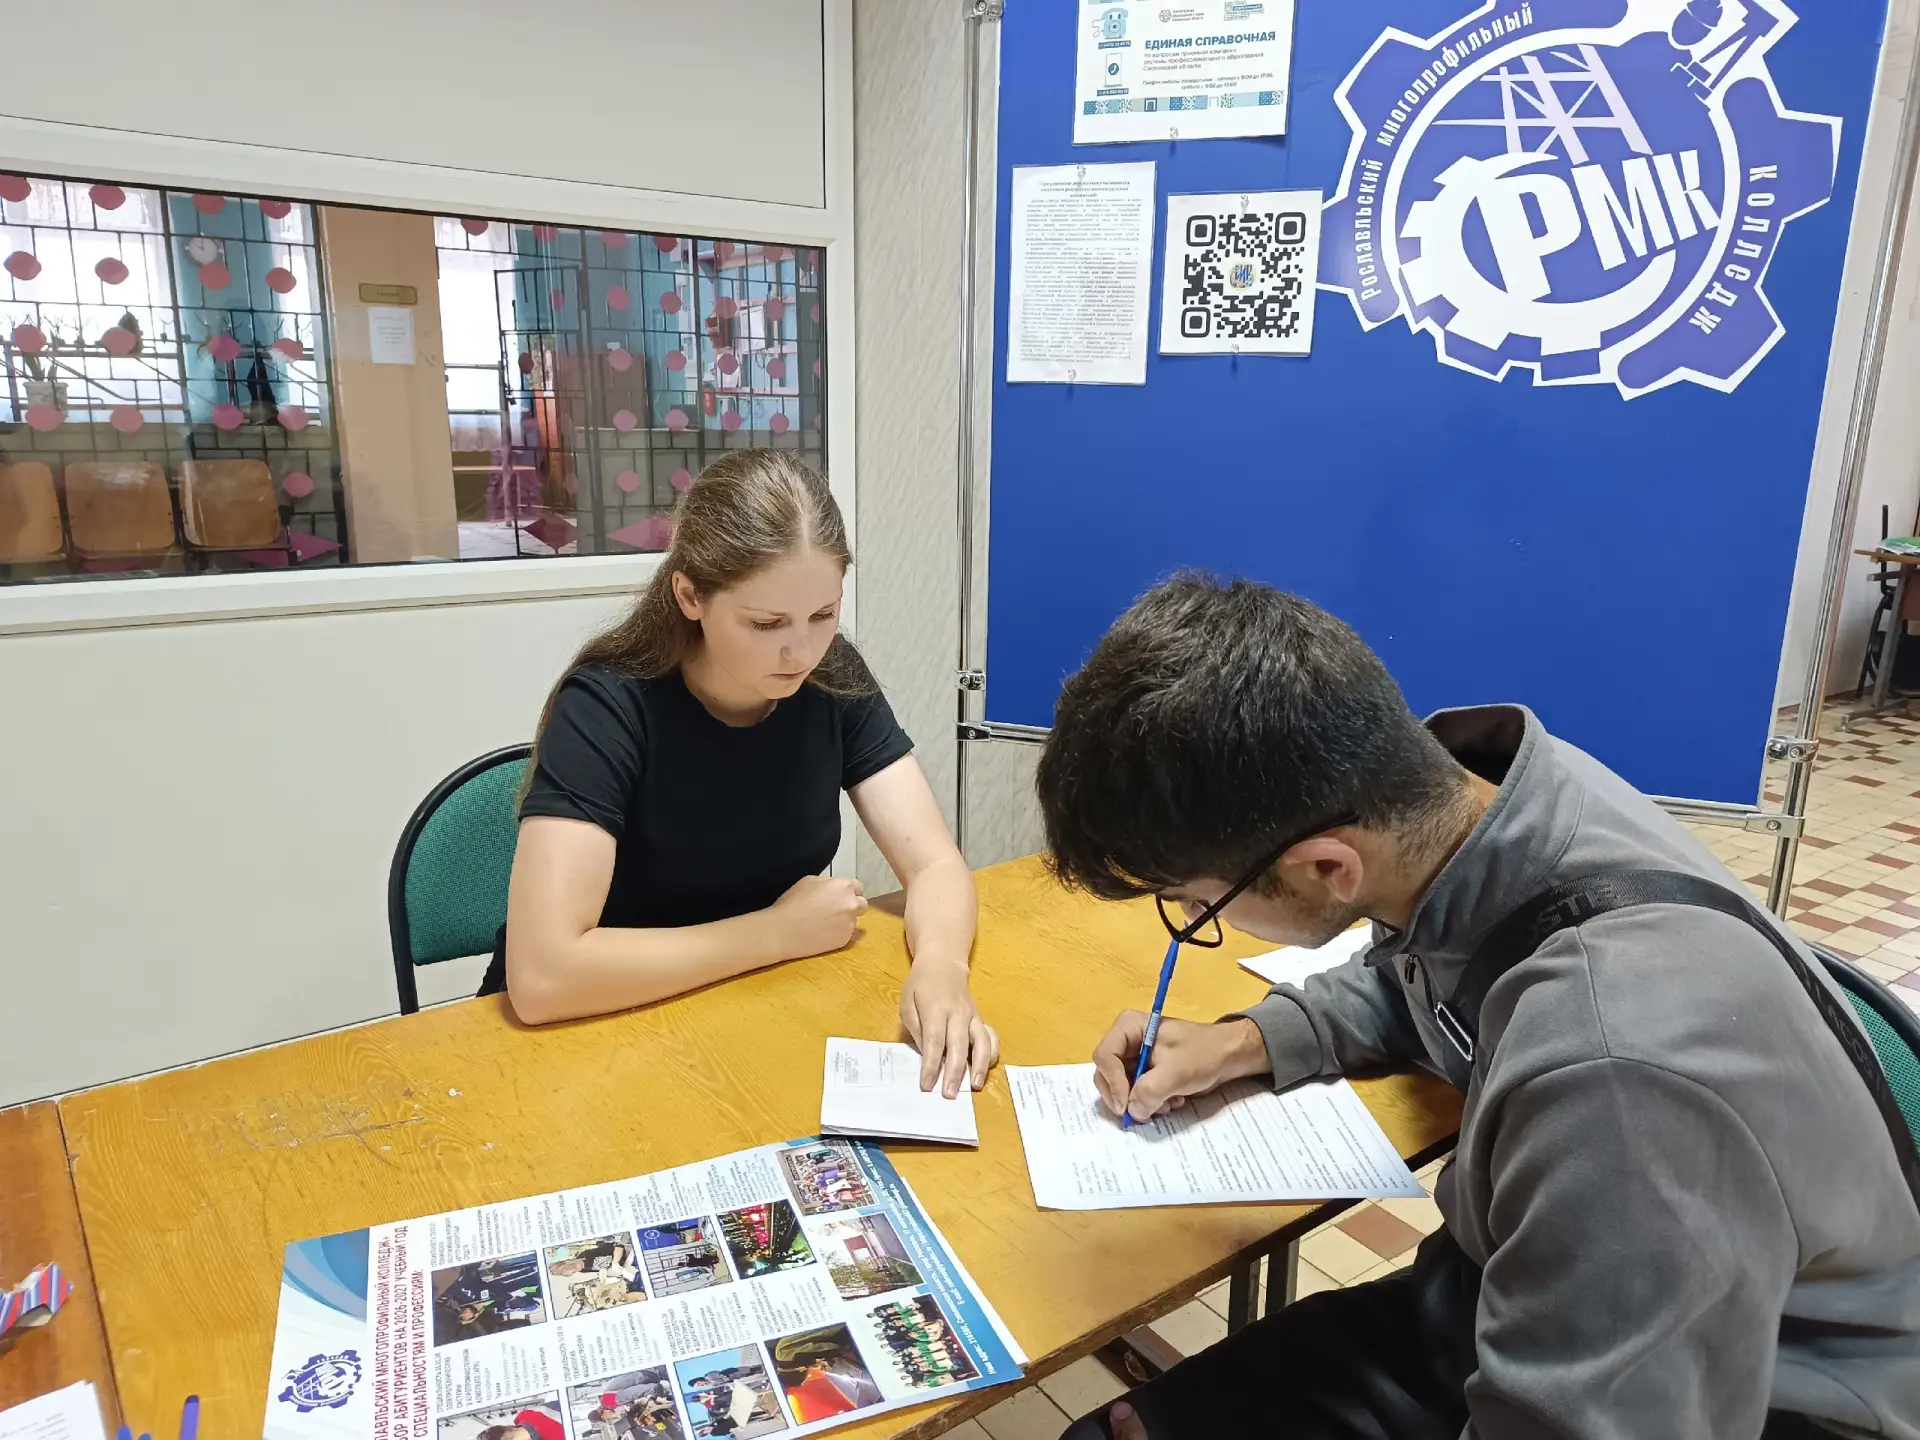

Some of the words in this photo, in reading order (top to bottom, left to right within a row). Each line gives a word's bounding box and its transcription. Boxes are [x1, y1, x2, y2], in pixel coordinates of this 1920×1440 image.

[1145, 38, 1193, 50] ЕДИНАЯ
[1194, 31, 1276, 47] СПРАВОЧНАЯ
[394, 1226, 408, 1243] ГОД
[392, 1244, 407, 1283] УЧЕБНЫЙ
[393, 1283, 407, 1325] 2026-2027
[412, 1268, 426, 1331] ПРОФЕССИЯМ:
[374, 1280, 389, 1378] МНОГОПРОФИЛЬНЫЙ
[394, 1326, 407, 1341] НА
[412, 1331, 425, 1340] И
[393, 1341, 408, 1420] АБИТУРИЕНТОВ
[412, 1340, 430, 1438] СПЕЦИАЛЬНОСТЯМ
